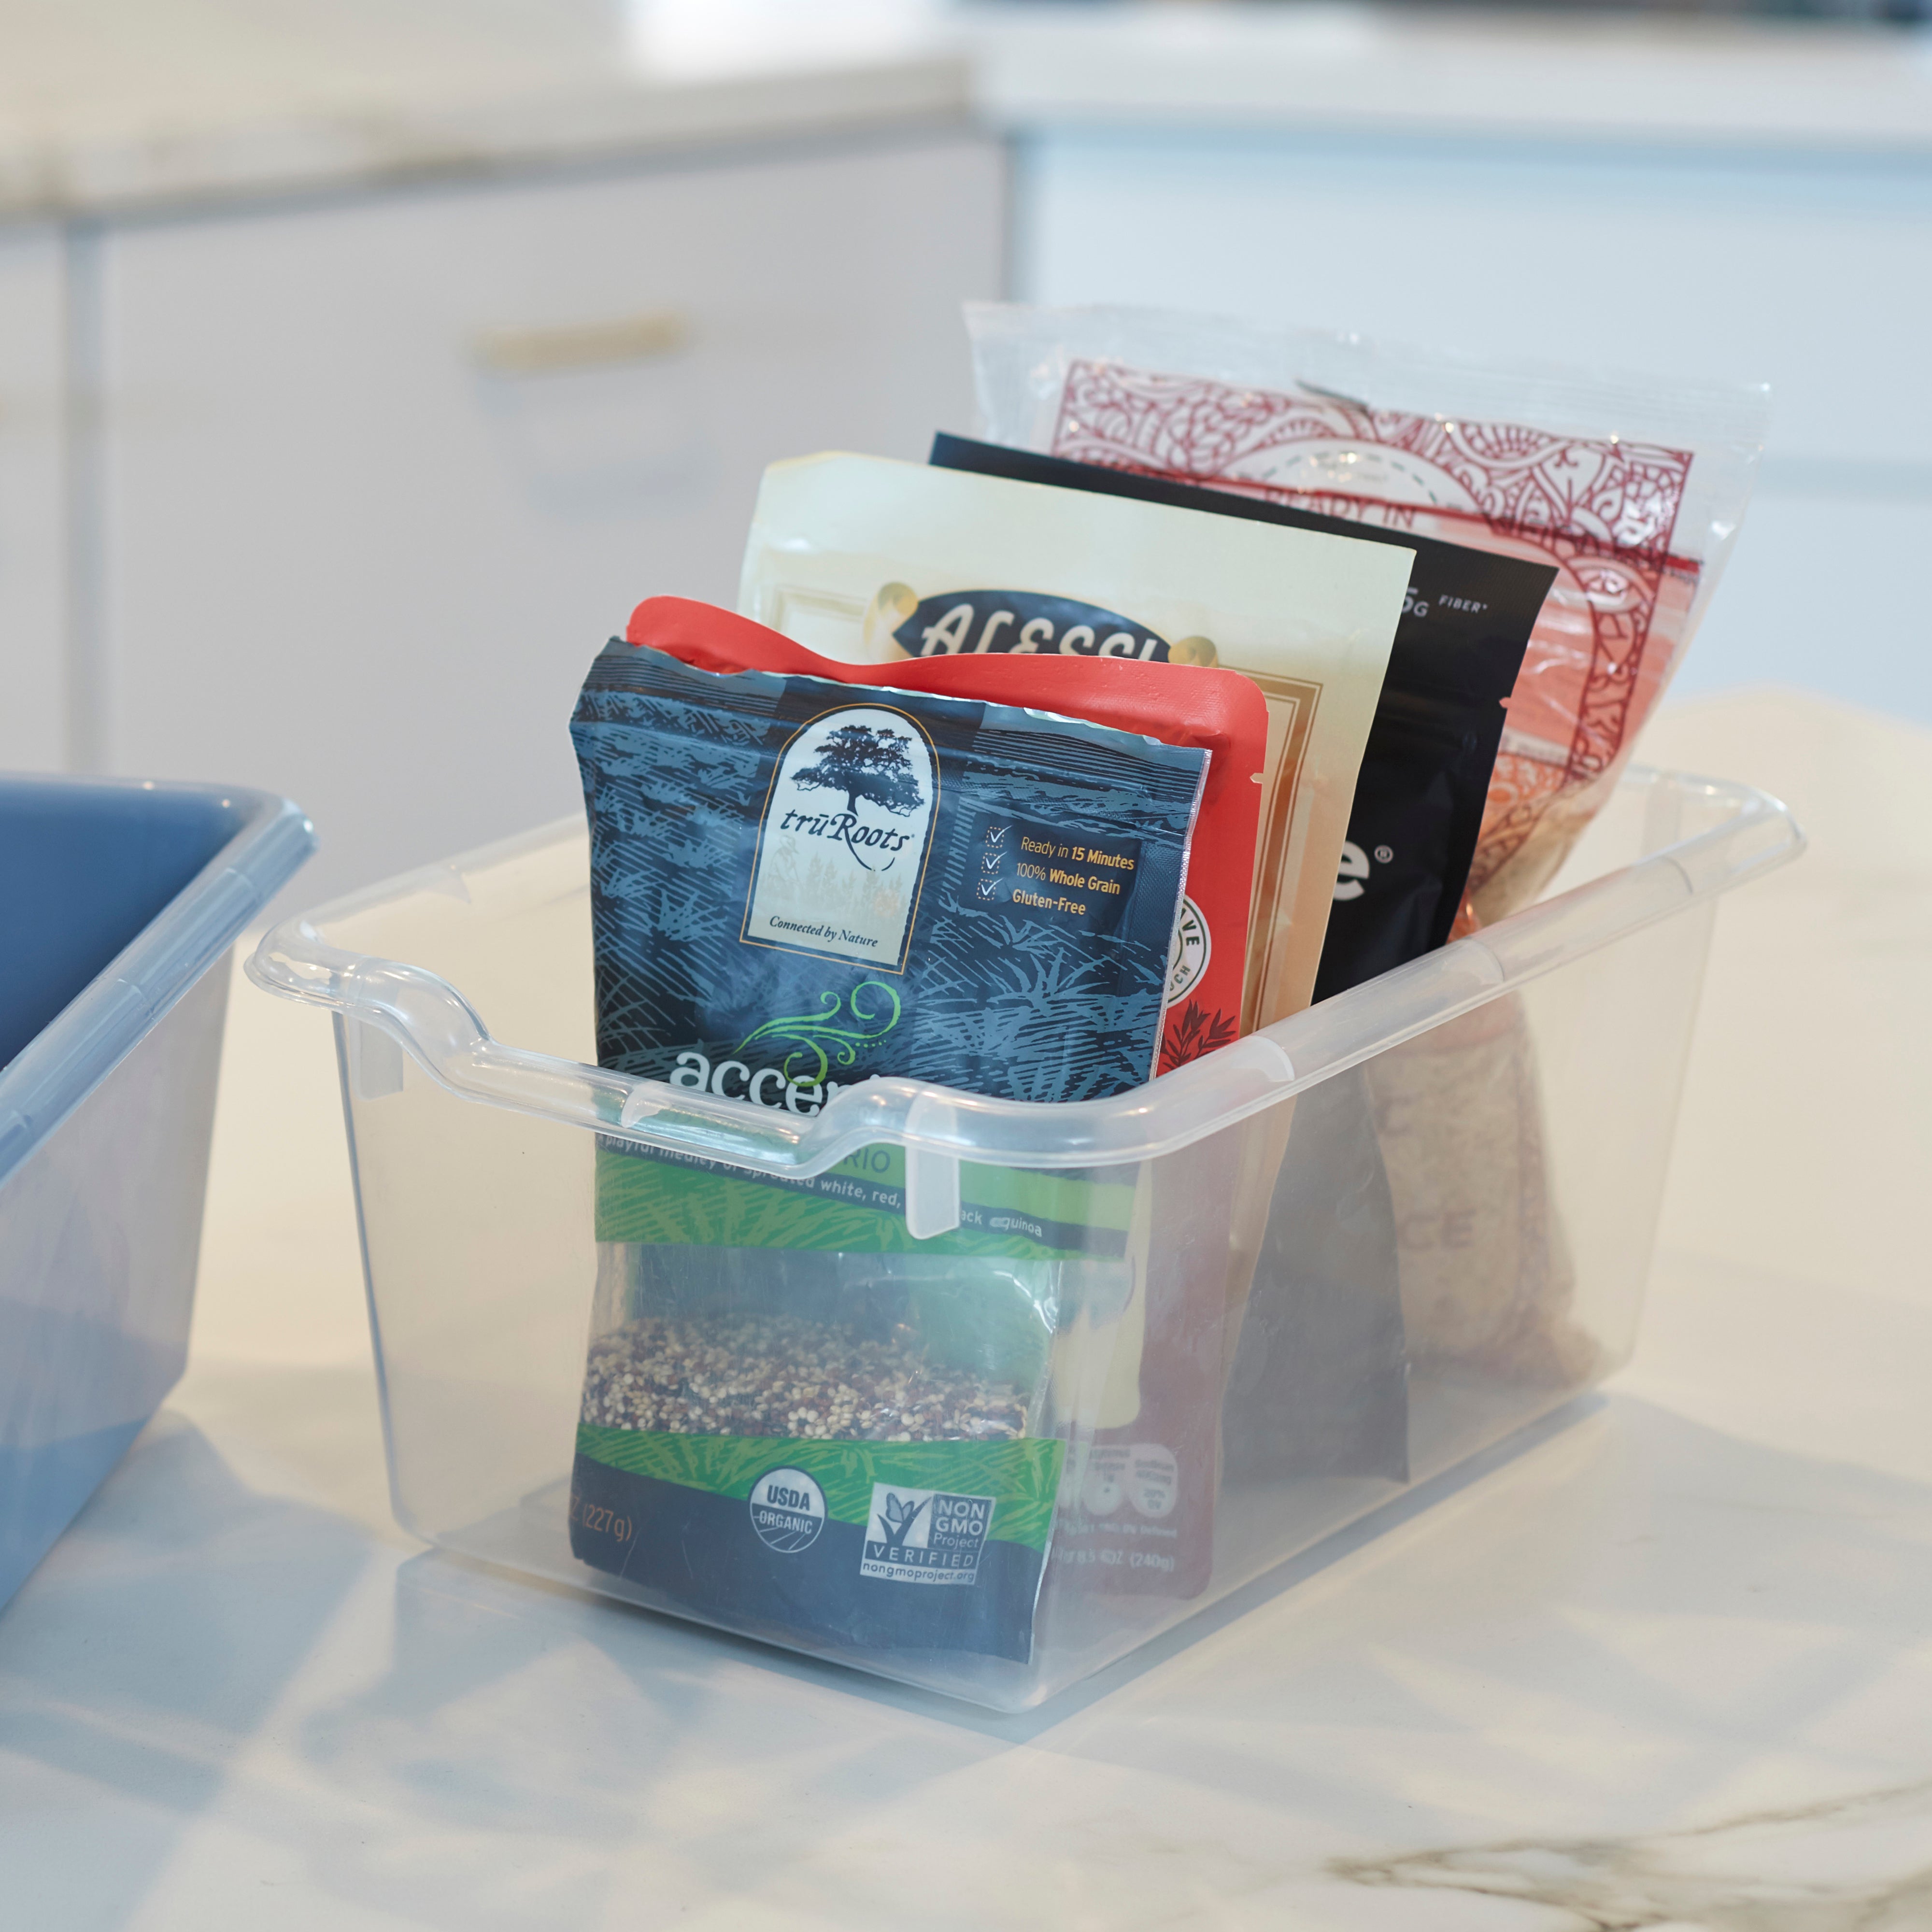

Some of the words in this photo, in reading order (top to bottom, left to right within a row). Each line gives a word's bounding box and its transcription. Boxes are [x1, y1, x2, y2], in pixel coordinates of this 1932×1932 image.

[1021, 836, 1056, 857] Ready
[1057, 842, 1068, 858] in
[1071, 846, 1085, 861] 15
[1086, 849, 1135, 870] Minutes
[1016, 862, 1046, 881] 100%
[1049, 867, 1085, 888] Whole
[1087, 876, 1121, 895] Grain
[1012, 889, 1086, 915] Gluten-Free
[769, 915, 824, 936] Connected
[824, 926, 837, 942] by
[838, 929, 879, 947] Nature
[669, 1051, 881, 1117] acce
[821, 1179, 867, 1201] white,
[872, 1190, 901, 1208] red,
[960, 1210, 982, 1225] ack
[767, 1484, 810, 1511] USDA
[938, 1499, 985, 1520] NON
[759, 1510, 813, 1534] ORGANIC
[936, 1517, 983, 1536] GMO
[933, 1533, 979, 1549] Project
[873, 1545, 973, 1567] VERIFIED
[863, 1562, 975, 1582] nongmoproject.org
